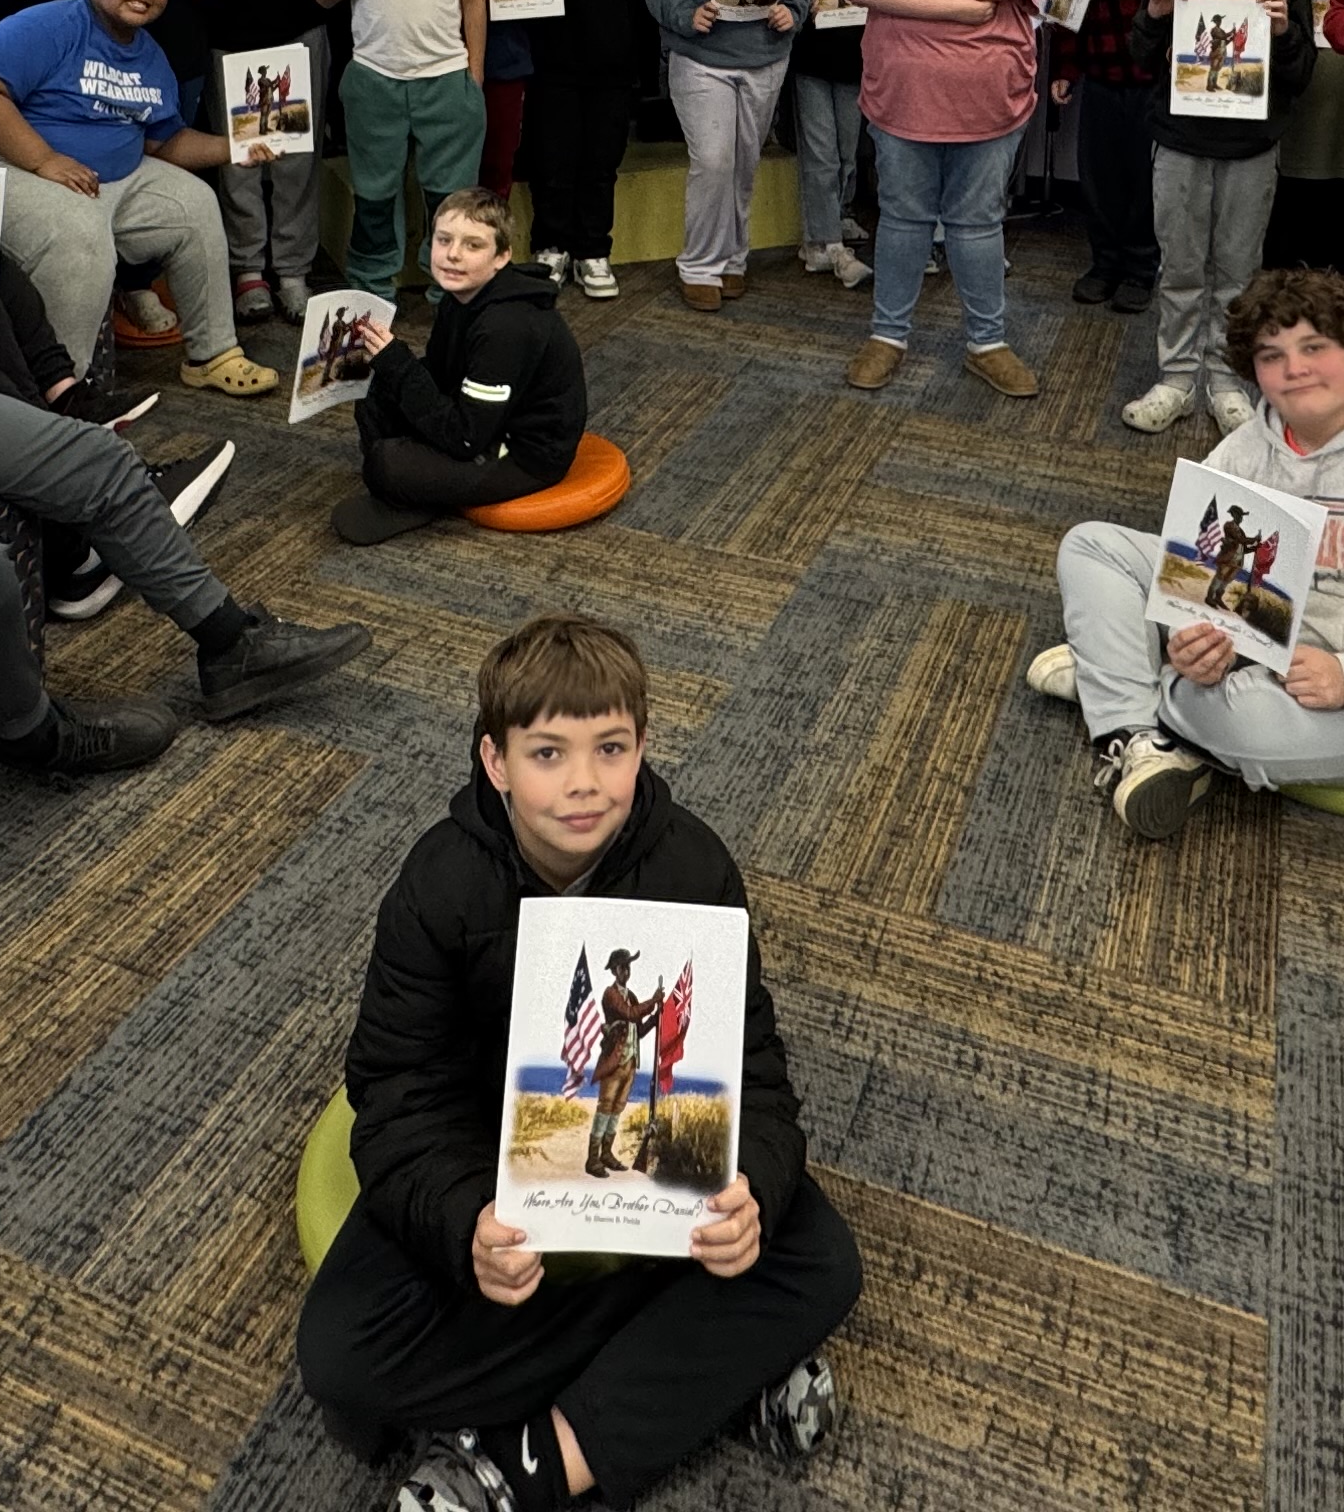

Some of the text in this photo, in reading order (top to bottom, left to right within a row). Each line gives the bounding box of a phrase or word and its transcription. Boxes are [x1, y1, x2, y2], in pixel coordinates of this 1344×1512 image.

[83, 59, 142, 86] WILDCAT
[79, 78, 163, 106] WEARHOUSE
[602, 1192, 650, 1210] Brother
